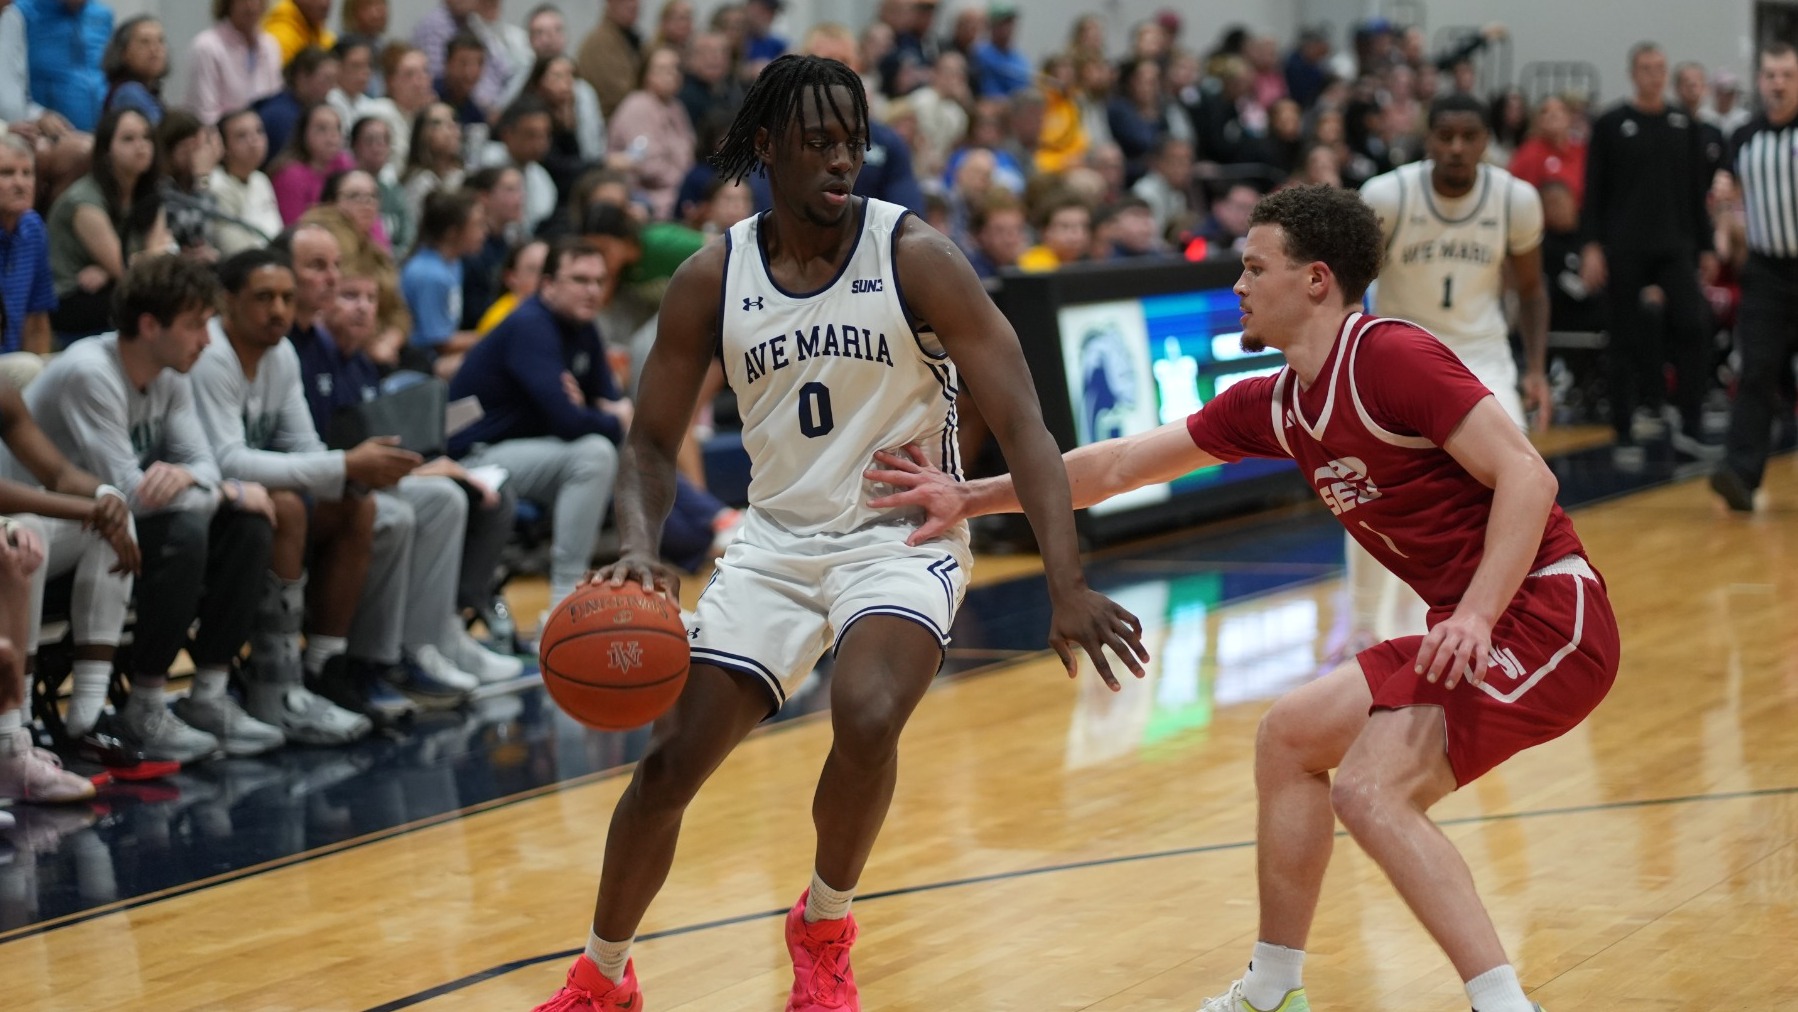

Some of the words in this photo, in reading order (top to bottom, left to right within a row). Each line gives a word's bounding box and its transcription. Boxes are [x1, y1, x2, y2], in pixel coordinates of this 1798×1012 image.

[1442, 275, 1453, 309] 1
[744, 334, 790, 384] AVE
[795, 323, 894, 368] MARIA
[798, 381, 835, 439] 0
